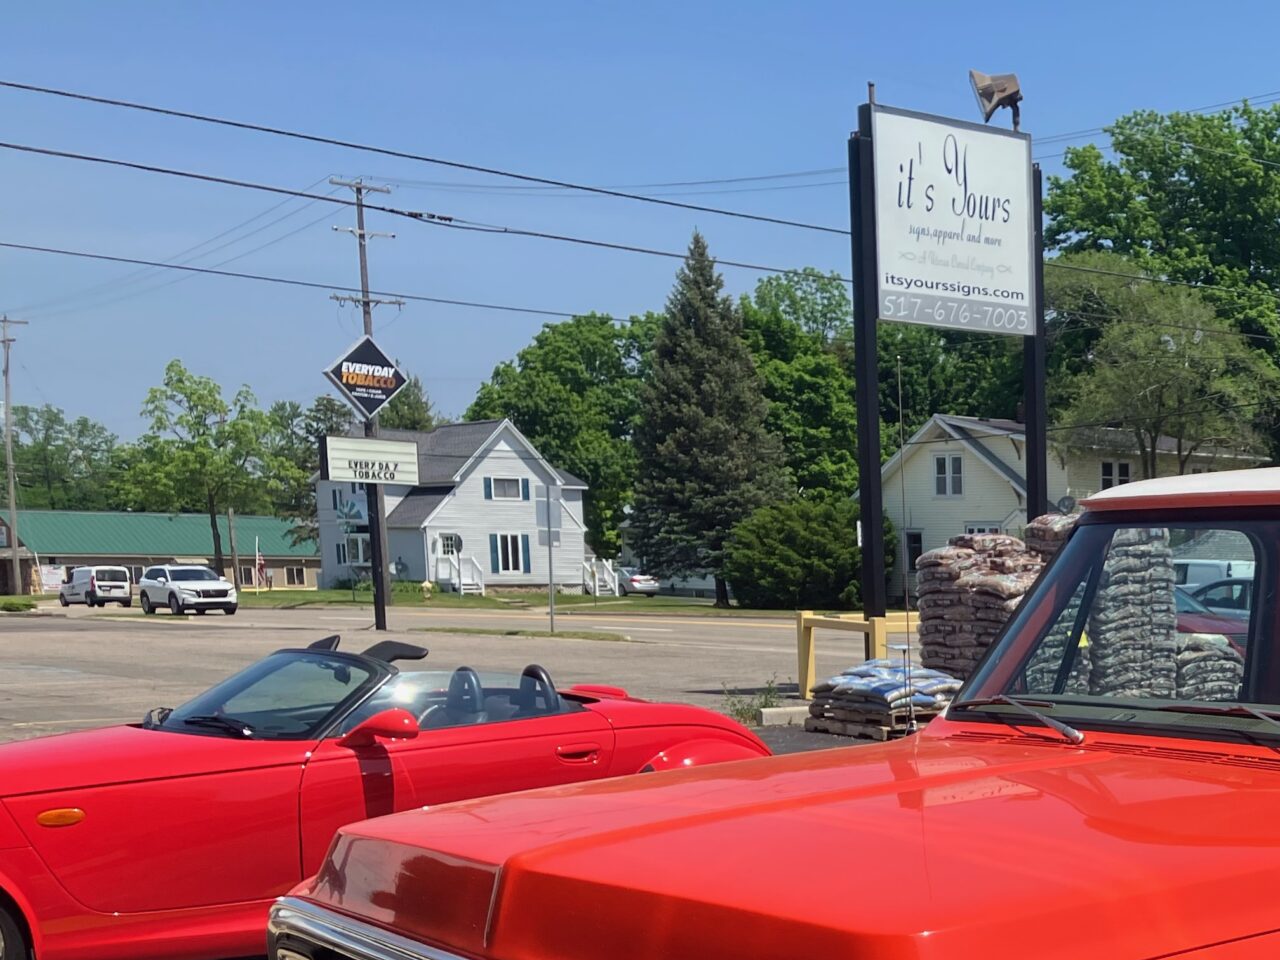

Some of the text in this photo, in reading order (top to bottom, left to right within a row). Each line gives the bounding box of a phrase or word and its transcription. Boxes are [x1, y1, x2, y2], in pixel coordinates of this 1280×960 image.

[897, 133, 1011, 224] it's Yours
[966, 222, 983, 244] and
[983, 235, 1003, 247] more
[885, 273, 1025, 301] itsyourssigns.com
[883, 295, 1029, 330] 517-676-7003
[341, 362, 395, 378] EVERYDAY
[341, 372, 396, 389] TOBACCO
[348, 460, 376, 470] EVERY
[354, 470, 395, 480] TOBACCO
